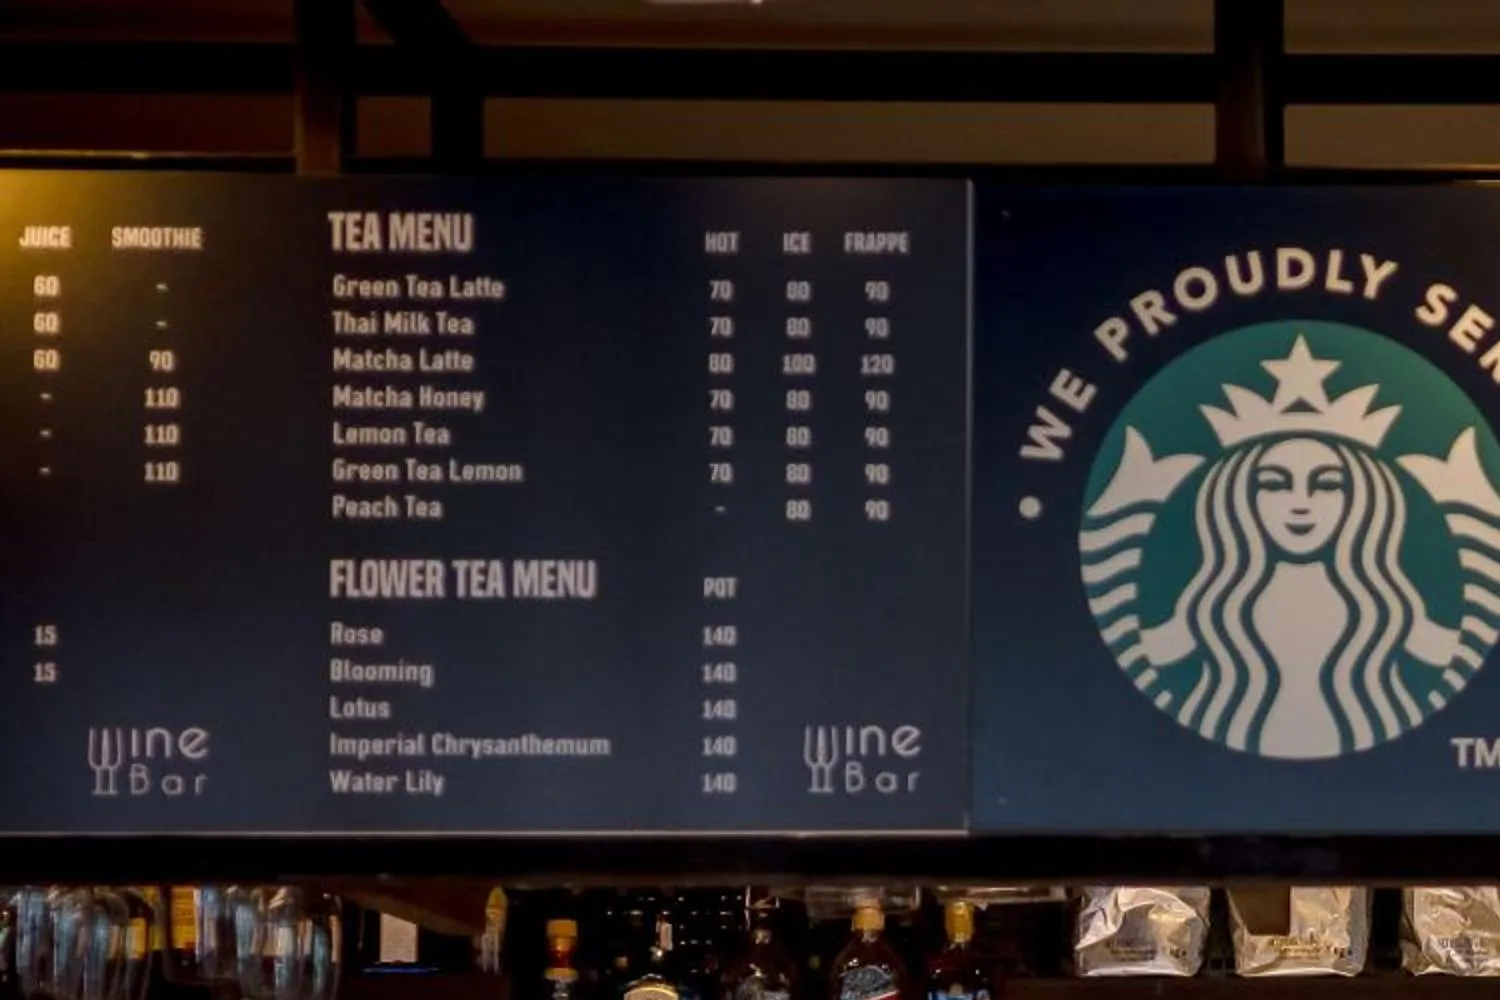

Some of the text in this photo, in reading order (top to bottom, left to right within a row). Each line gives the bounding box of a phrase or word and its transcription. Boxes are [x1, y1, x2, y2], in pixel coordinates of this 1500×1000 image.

[18, 225, 71, 249] JUICE
[111, 226, 202, 250] SMOOTHIE
[327, 211, 473, 252] TEA MENU
[704, 231, 739, 253] HOT
[783, 231, 811, 254] ICE
[844, 231, 908, 254] FRAPPE
[33, 274, 61, 297] 60
[332, 273, 505, 299] Green Tea Latte
[710, 279, 733, 302] 70
[786, 280, 811, 302] 80
[864, 280, 890, 302] 90
[33, 311, 60, 335] 60
[331, 310, 475, 336] Thai Milk Tea
[709, 316, 733, 337] 70
[786, 316, 811, 338] 80
[864, 317, 890, 339] 90
[33, 348, 60, 371] 60
[149, 350, 175, 373] 90
[332, 347, 474, 372] Matcha Latte
[708, 352, 734, 374] 80
[782, 353, 816, 374] 100
[860, 353, 895, 375] 120
[1020, 367, 1098, 463] WE
[1094, 247, 1398, 363] PROUDLY
[145, 387, 180, 409] 110
[332, 384, 485, 412] Matcha Honey
[709, 389, 734, 410] 70
[786, 389, 811, 411] 80
[864, 390, 890, 411] 90
[144, 423, 180, 446] 110
[332, 421, 451, 446] Lemon Tea
[709, 426, 733, 447] 70
[785, 426, 812, 447] 80
[864, 426, 890, 448] 90
[144, 460, 180, 482] 110
[332, 457, 523, 482] Green Tea Lemon
[709, 462, 733, 484] 70
[785, 463, 811, 484] 80
[864, 463, 890, 485] 90
[332, 494, 443, 519] Peach Tea
[785, 499, 812, 521] 80
[864, 499, 890, 521] 90
[329, 559, 597, 599] FLOWER TEA MENU
[703, 576, 737, 599] POT
[34, 624, 58, 646] 15
[330, 621, 384, 645] Rose
[703, 625, 737, 647] 140
[34, 661, 57, 683] 15
[329, 658, 434, 688] Blooming
[702, 662, 737, 683] 140
[329, 695, 391, 719] Lotus
[702, 698, 737, 720] 140
[329, 731, 611, 761] Imperial Chrysanthemum
[702, 735, 737, 757] 140
[128, 763, 208, 795] Bar
[329, 769, 445, 797] Water Lily
[702, 772, 737, 793] 140
[845, 762, 920, 793] Bar
